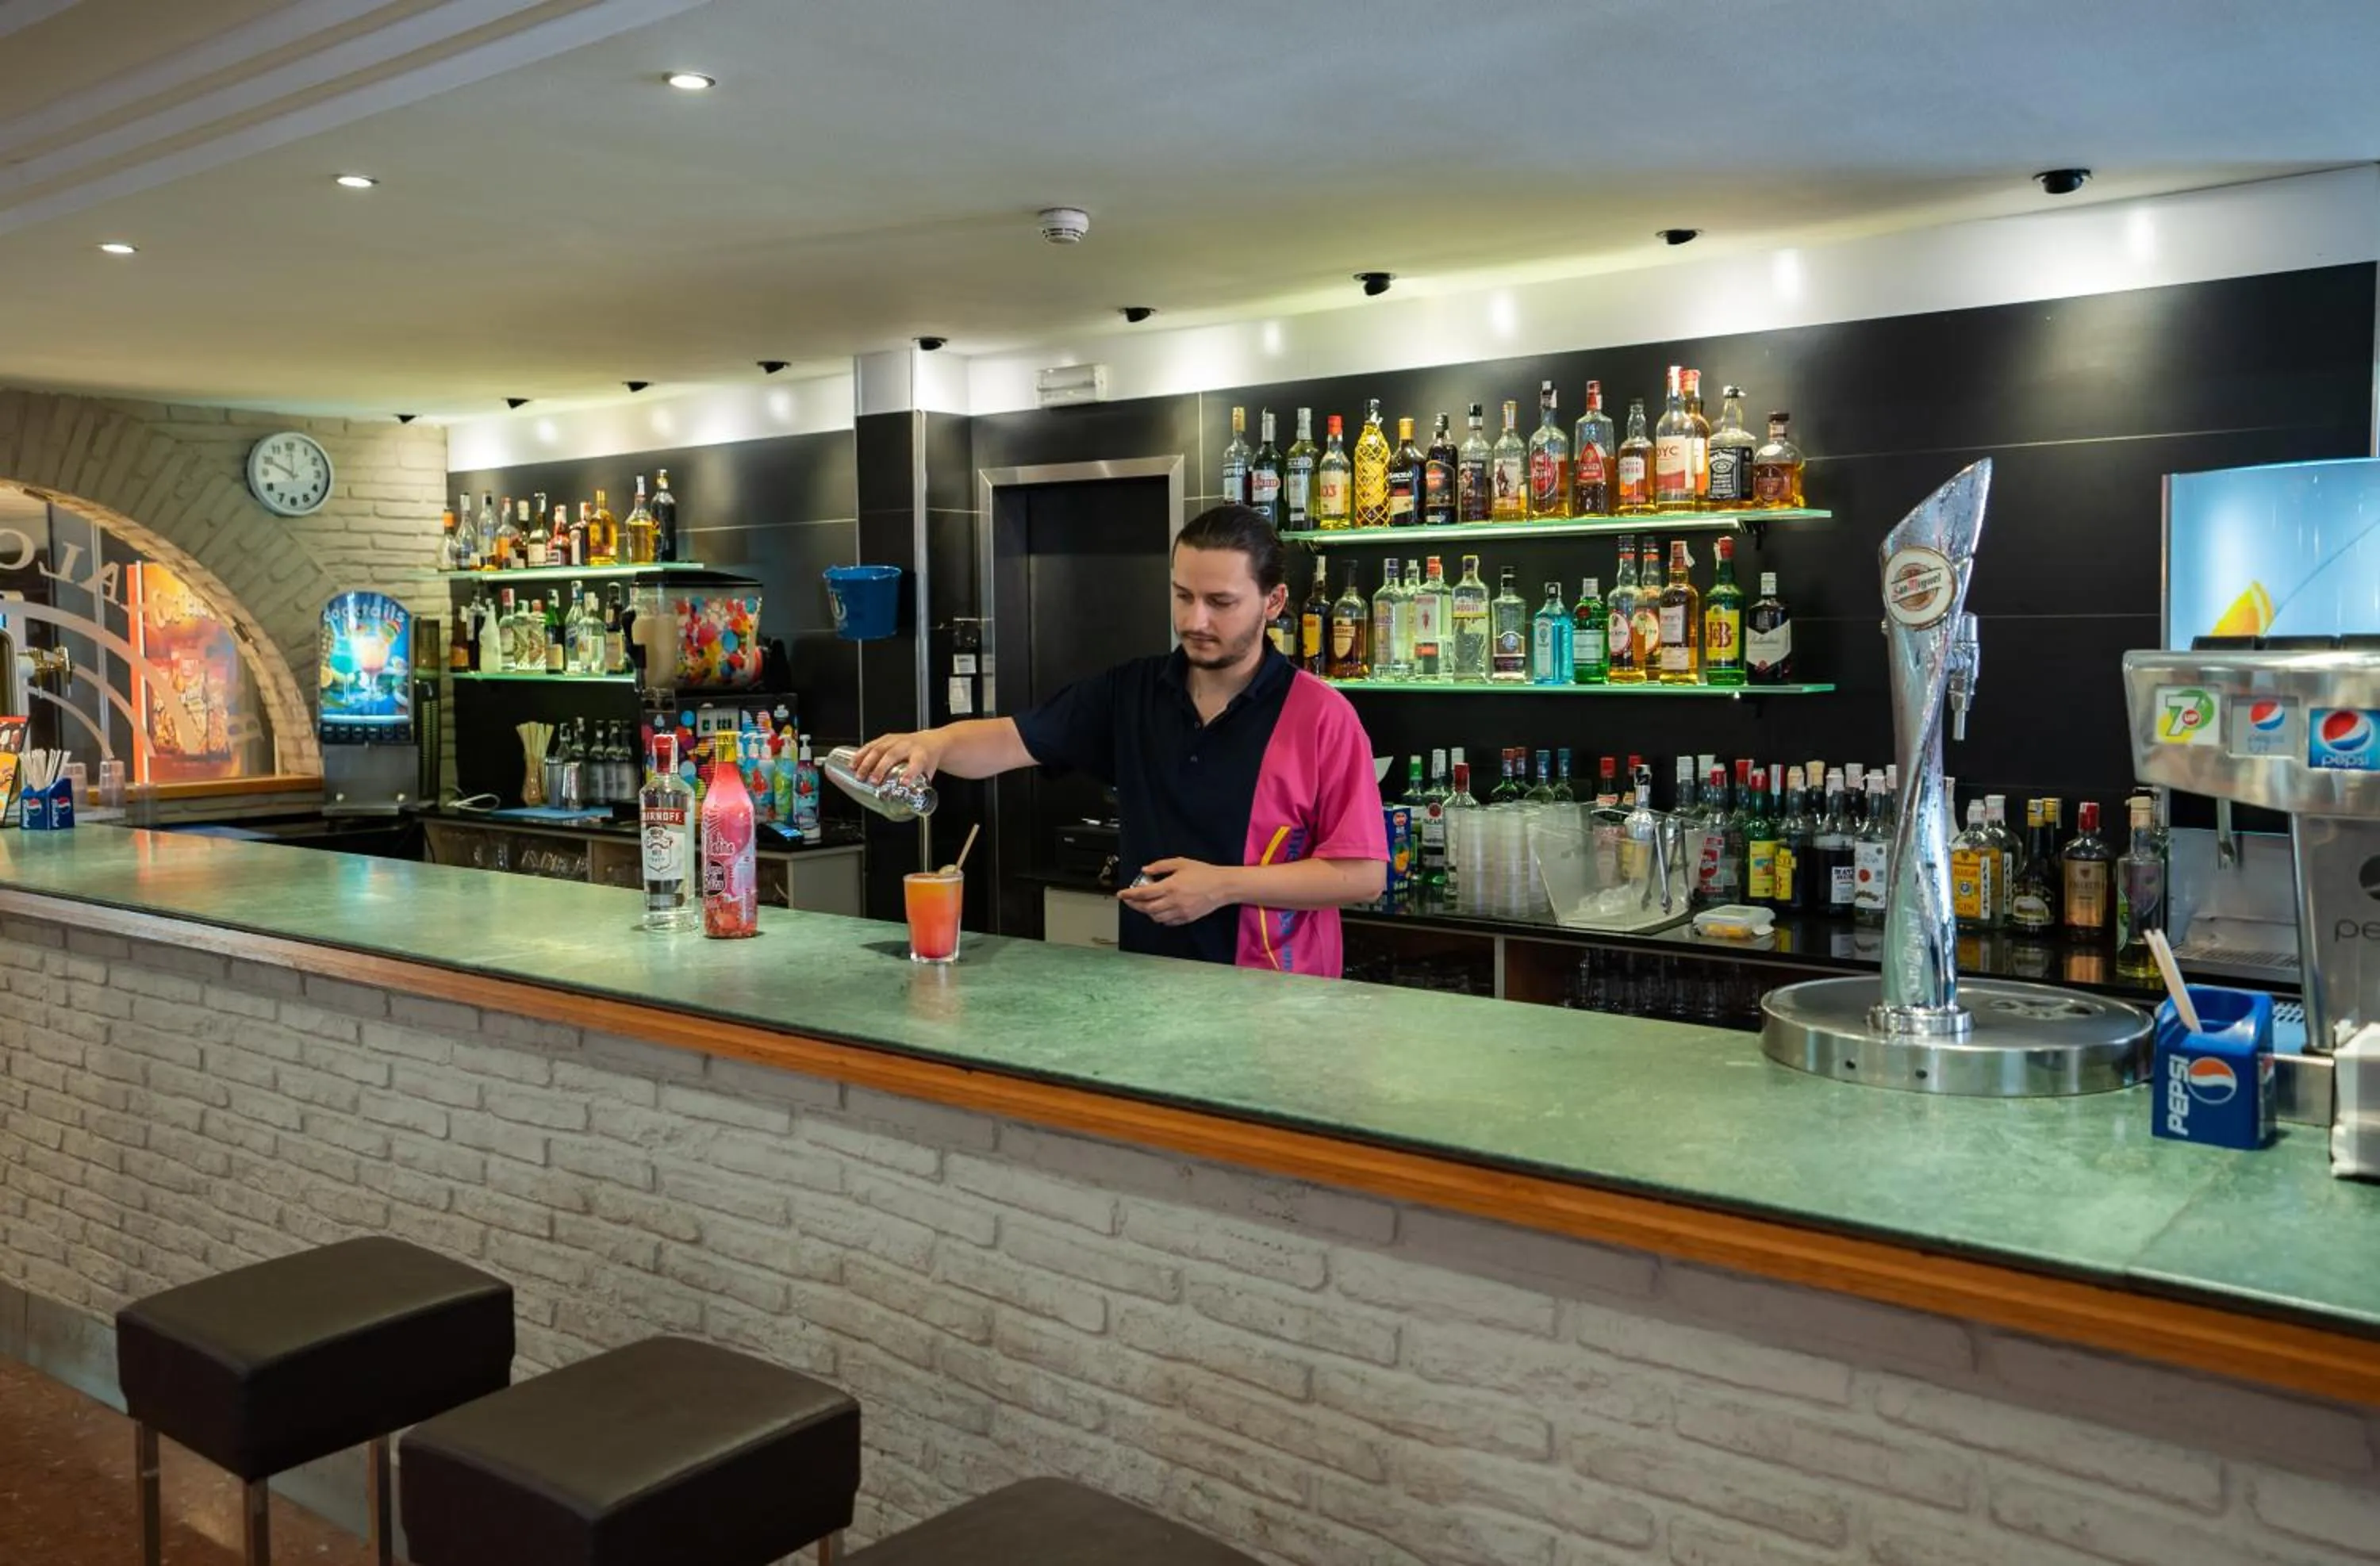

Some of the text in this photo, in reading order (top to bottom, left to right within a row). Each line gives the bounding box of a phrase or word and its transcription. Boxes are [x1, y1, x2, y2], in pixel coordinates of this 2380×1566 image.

[2321, 752, 2370, 767] pepsi
[641, 811, 682, 823] MIRNOFF
[2335, 919, 2380, 942] pe
[2167, 1054, 2190, 1137] PEPSI
